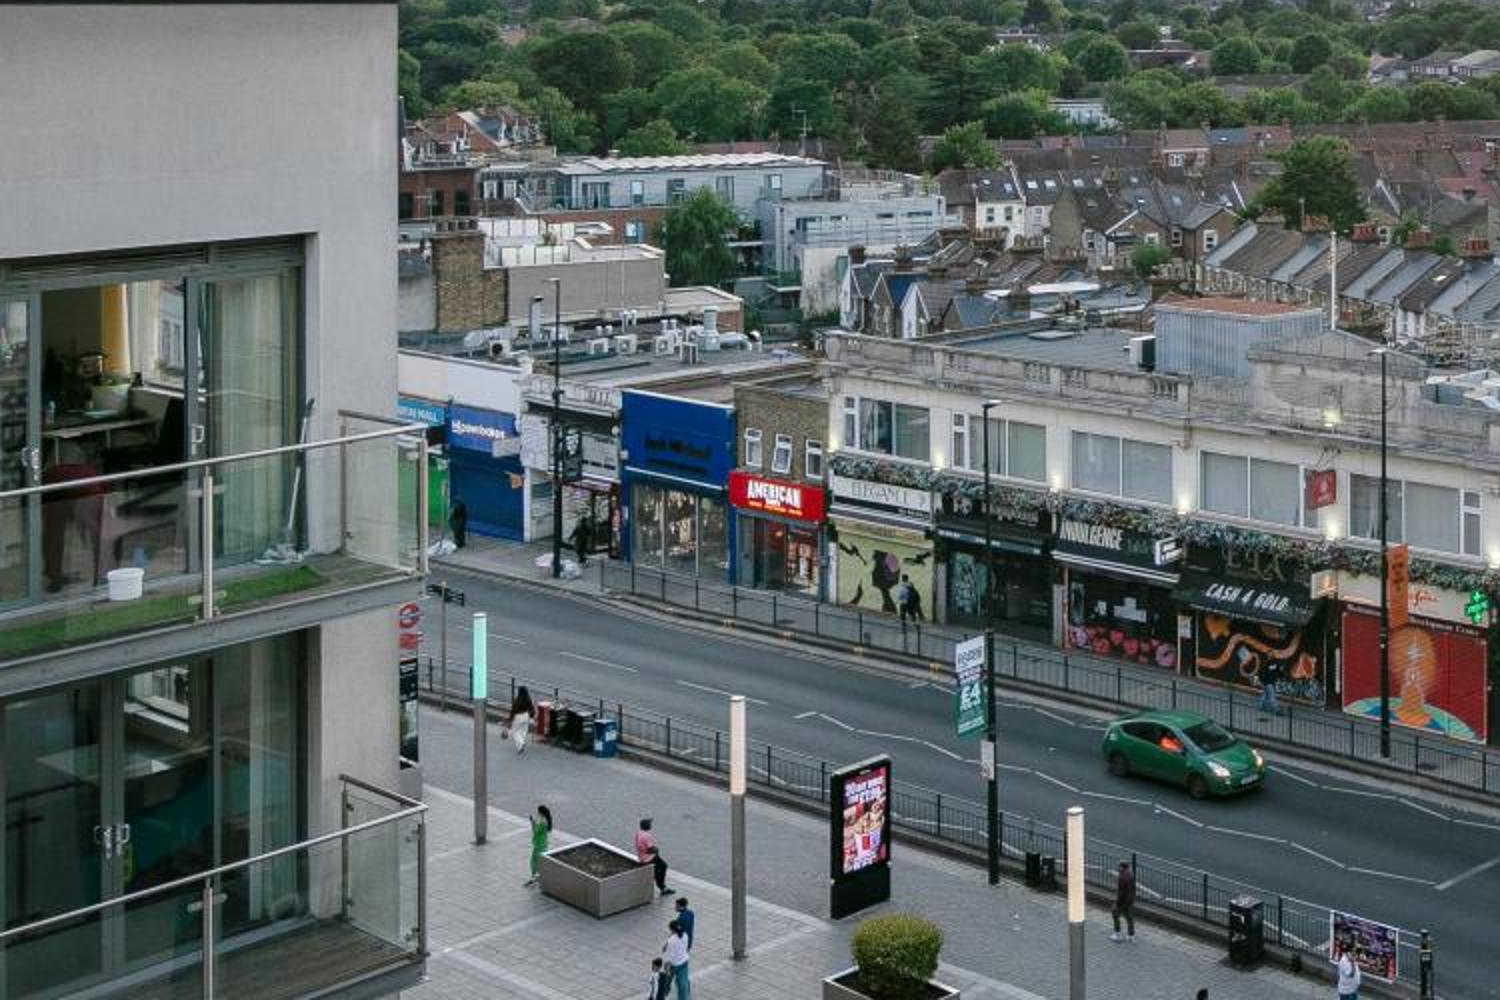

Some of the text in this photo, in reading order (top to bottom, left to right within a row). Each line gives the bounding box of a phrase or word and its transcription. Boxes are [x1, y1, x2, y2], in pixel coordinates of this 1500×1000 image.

[747, 479, 802, 509] AMERICAN
[1205, 583, 1290, 611] CASH 4 GOLD
